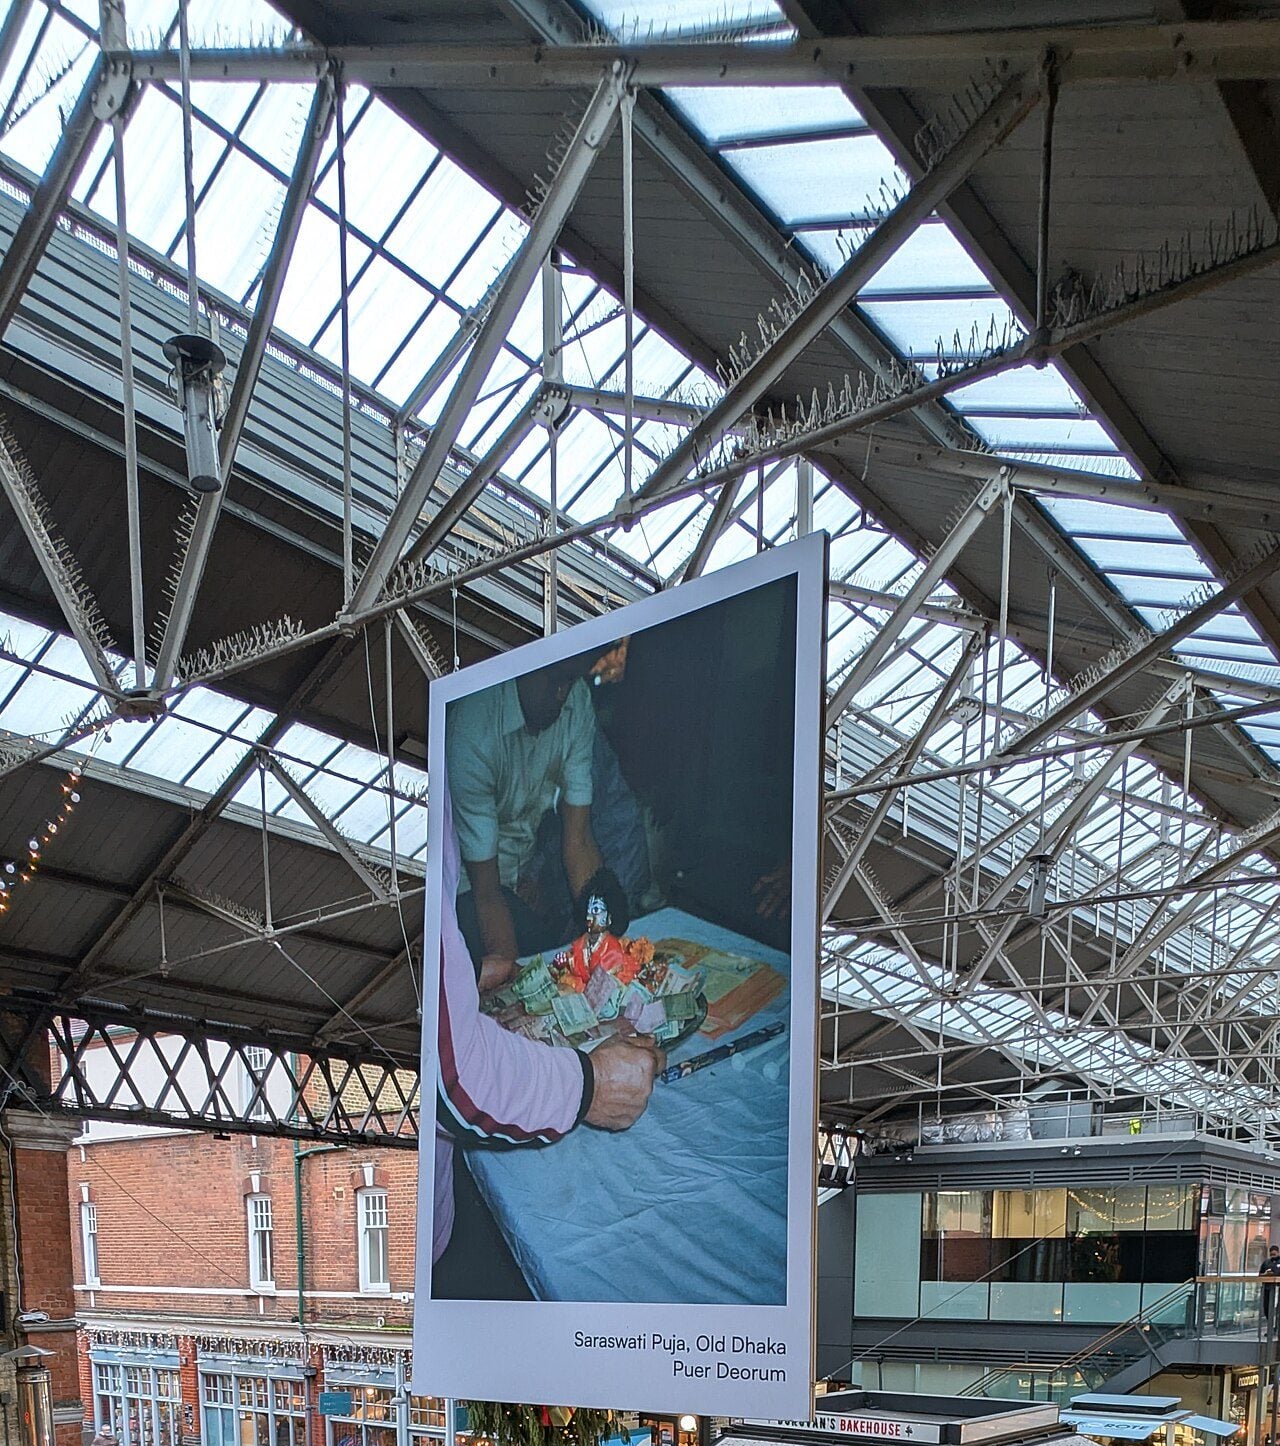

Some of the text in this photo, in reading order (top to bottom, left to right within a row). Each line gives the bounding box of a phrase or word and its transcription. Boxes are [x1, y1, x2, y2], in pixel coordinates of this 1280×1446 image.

[574, 1331, 787, 1355] Saraswati Puja, Old Dhaka
[673, 1360, 786, 1382] Puer Deorum
[840, 1418, 901, 1437] BAKEHOUSE
